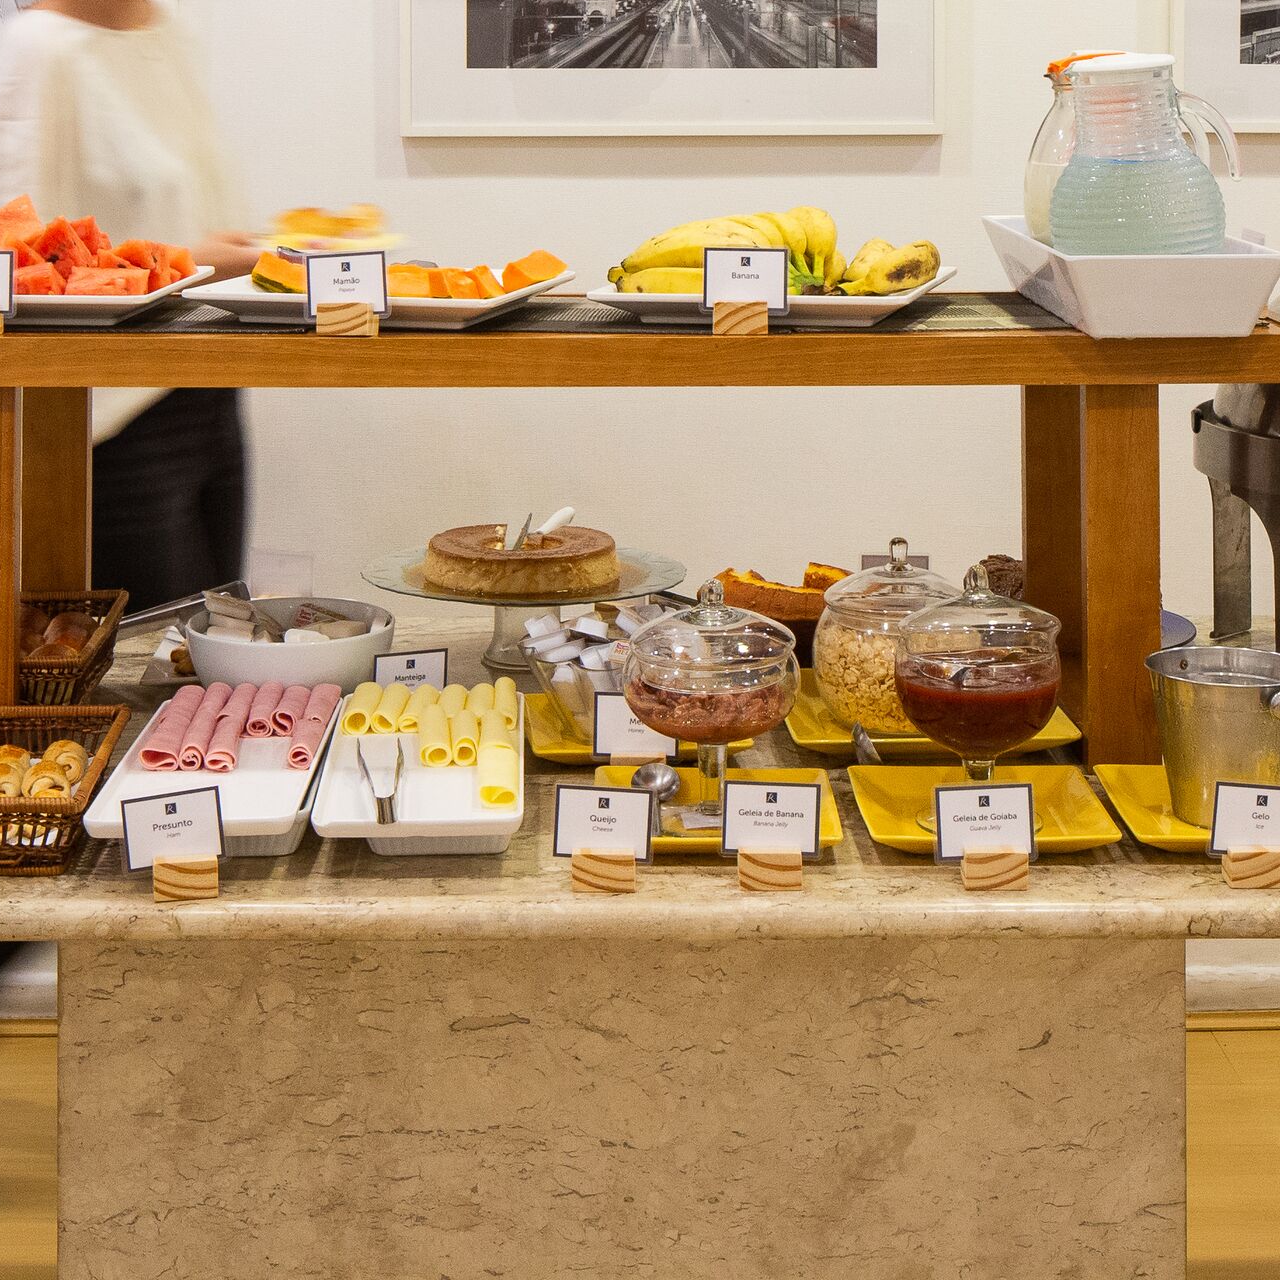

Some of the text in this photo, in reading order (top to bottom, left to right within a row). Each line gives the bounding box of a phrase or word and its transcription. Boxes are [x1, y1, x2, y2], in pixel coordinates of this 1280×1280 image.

[333, 277, 360, 285] Mamão
[738, 808, 762, 817] Geleia
[764, 809, 774, 817] de
[1252, 812, 1270, 820] Gelo
[589, 814, 617, 824] Queijo
[978, 814, 989, 822] de
[152, 819, 193, 832] Presunto
